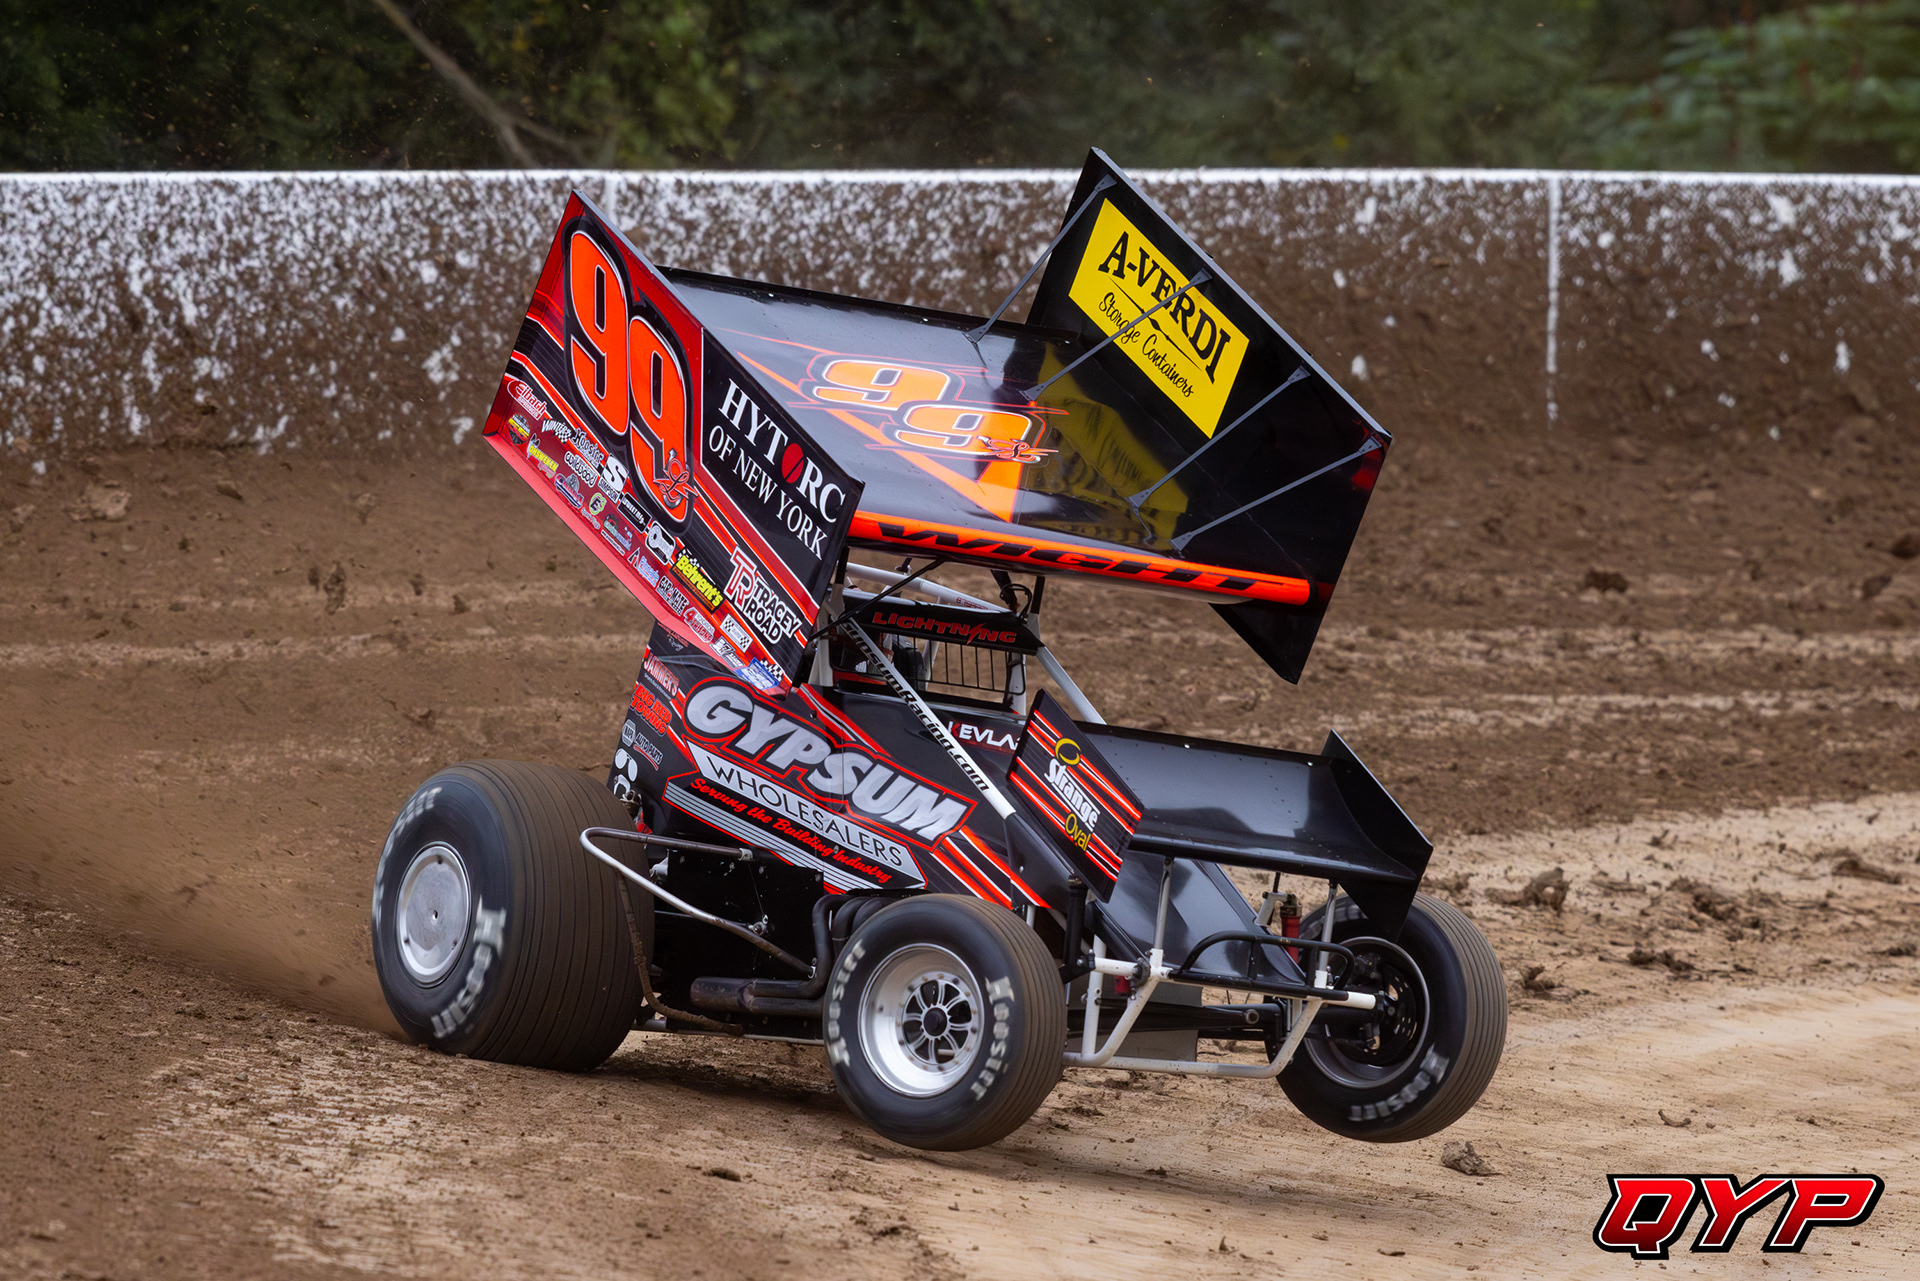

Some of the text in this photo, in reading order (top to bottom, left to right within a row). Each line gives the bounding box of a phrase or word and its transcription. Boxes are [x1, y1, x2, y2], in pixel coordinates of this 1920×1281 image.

[1098, 231, 1231, 384] A-VERDI
[1098, 292, 1194, 398] Storage Containers
[515, 383, 547, 414] Eibach
[569, 230, 687, 523] 99
[813, 359, 1032, 456] 99
[602, 455, 627, 492] S
[718, 378, 846, 523] HYTORC
[600, 478, 619, 501] SIMPSON
[709, 425, 828, 560] OF NEW YORK
[676, 555, 723, 607] Behrent's
[877, 521, 1283, 590] WIGHT
[746, 597, 781, 639] ROAD
[753, 580, 801, 636] TRACEY
[872, 612, 1018, 645] LIGHTNING
[643, 652, 680, 697] JAMMER'S
[631, 695, 667, 734] TOWING
[635, 683, 672, 723] BIG RED
[686, 684, 968, 841] GYPSUM
[948, 721, 1022, 750] KEVLA
[707, 755, 903, 867] WHOLESALERS
[1044, 758, 1099, 831] Strange
[690, 778, 892, 884] Serving the Building Industry
[1065, 813, 1092, 851] Oval
